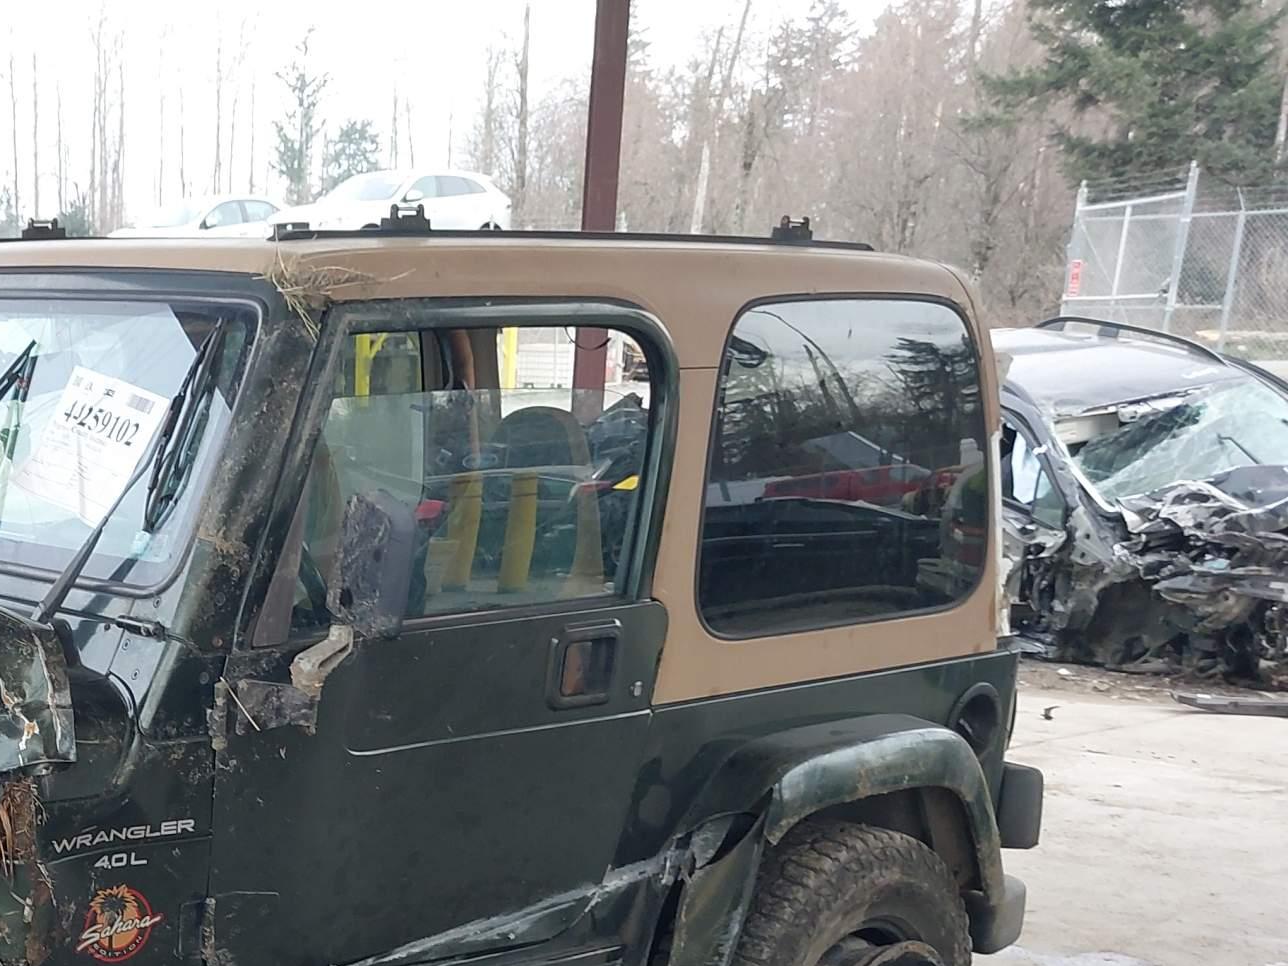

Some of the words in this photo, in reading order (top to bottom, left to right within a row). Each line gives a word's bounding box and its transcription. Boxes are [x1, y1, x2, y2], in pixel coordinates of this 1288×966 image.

[64, 400, 140, 447] 44259102
[52, 819, 196, 854] WRANGLER
[76, 914, 162, 952] Sahara
[93, 935, 143, 958] EDITION
